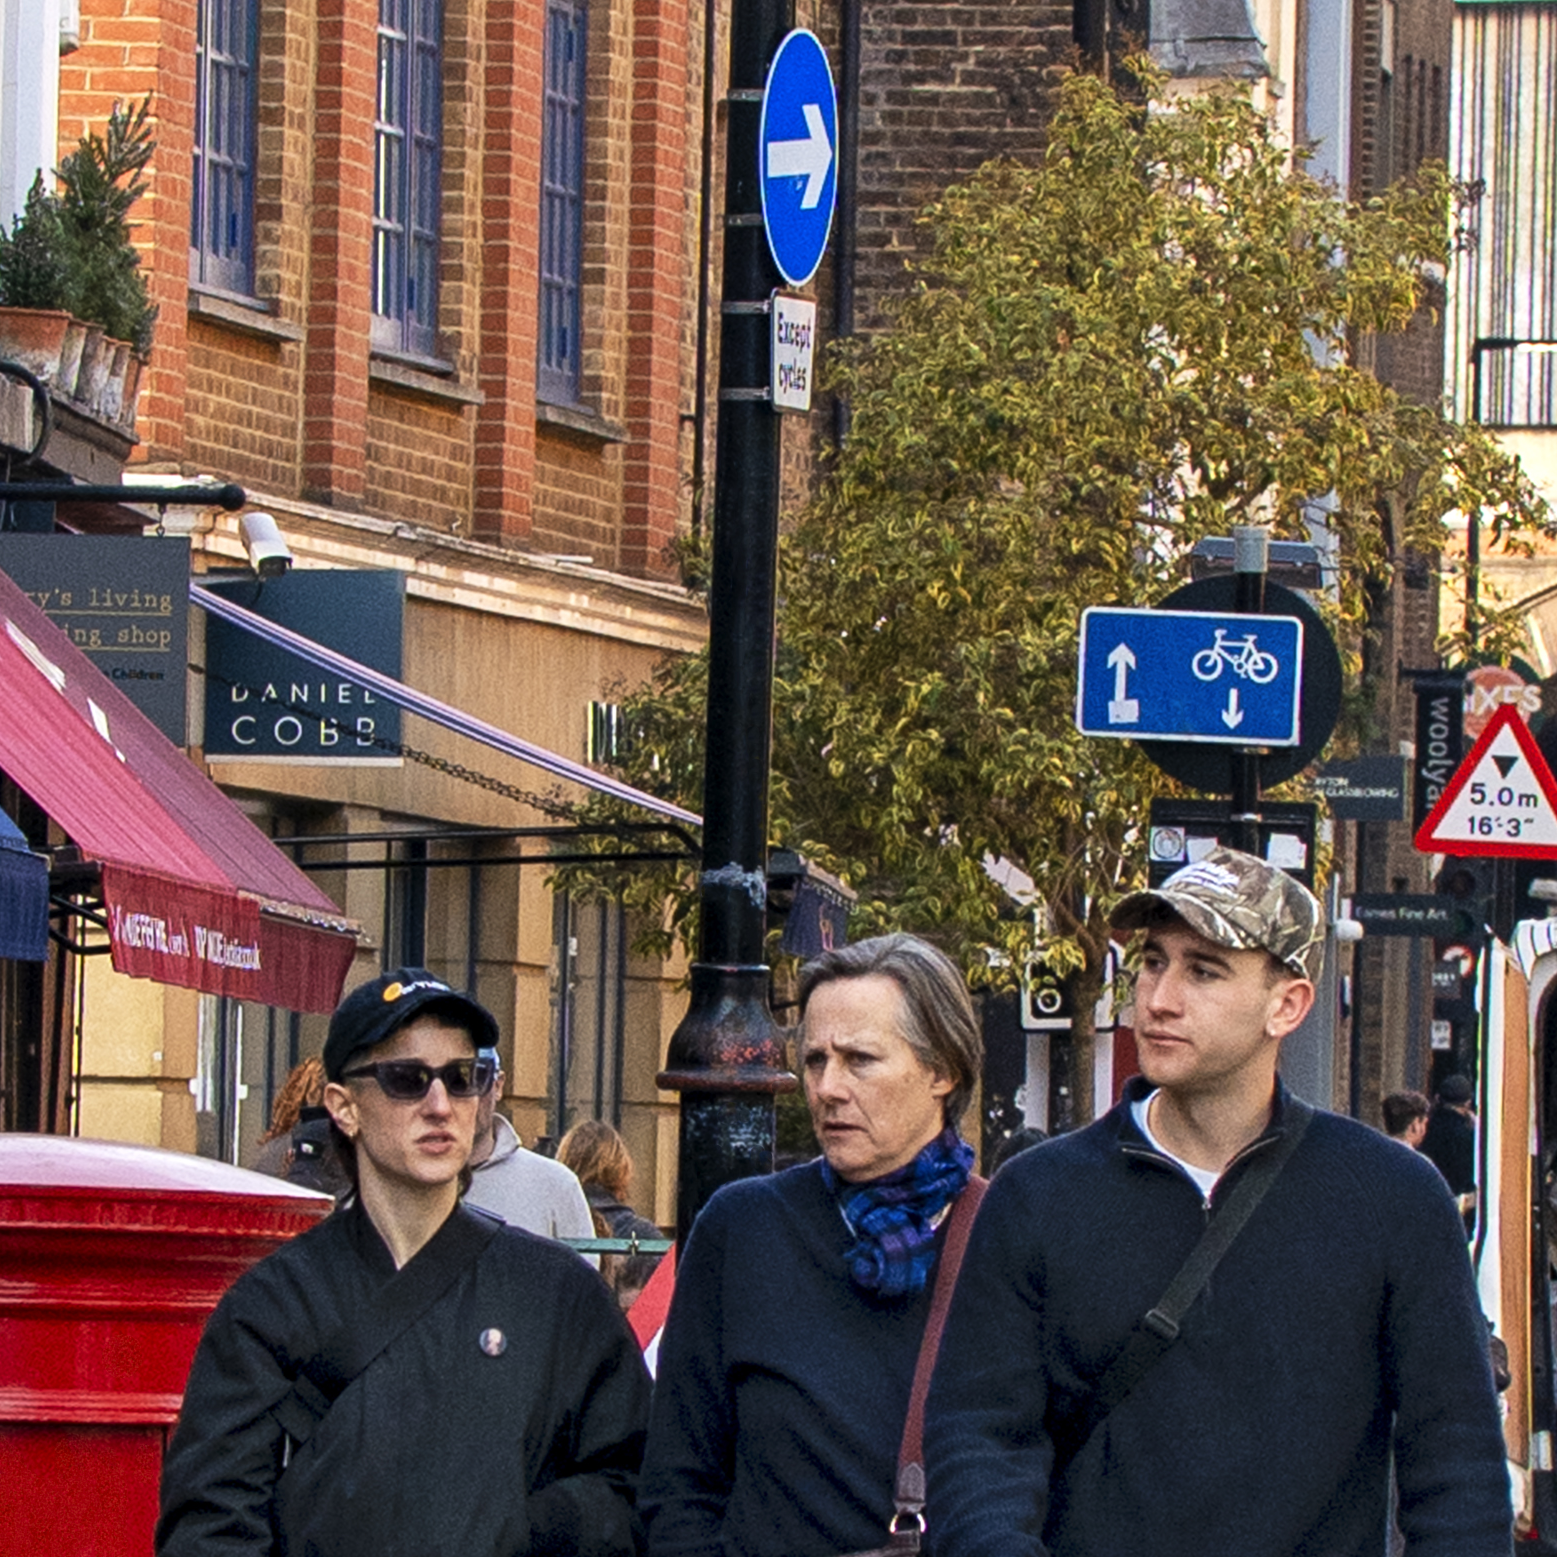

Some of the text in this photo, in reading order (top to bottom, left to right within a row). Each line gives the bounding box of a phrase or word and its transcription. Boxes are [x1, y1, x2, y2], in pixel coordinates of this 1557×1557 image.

[778, 312, 811, 353] Except
[778, 358, 807, 394] cycles
[89, 588, 173, 613] living
[117, 625, 172, 648] shop
[231, 682, 376, 704] DANIEL
[231, 715, 376, 746] COBB
[1399, 906, 1425, 919] Fine
